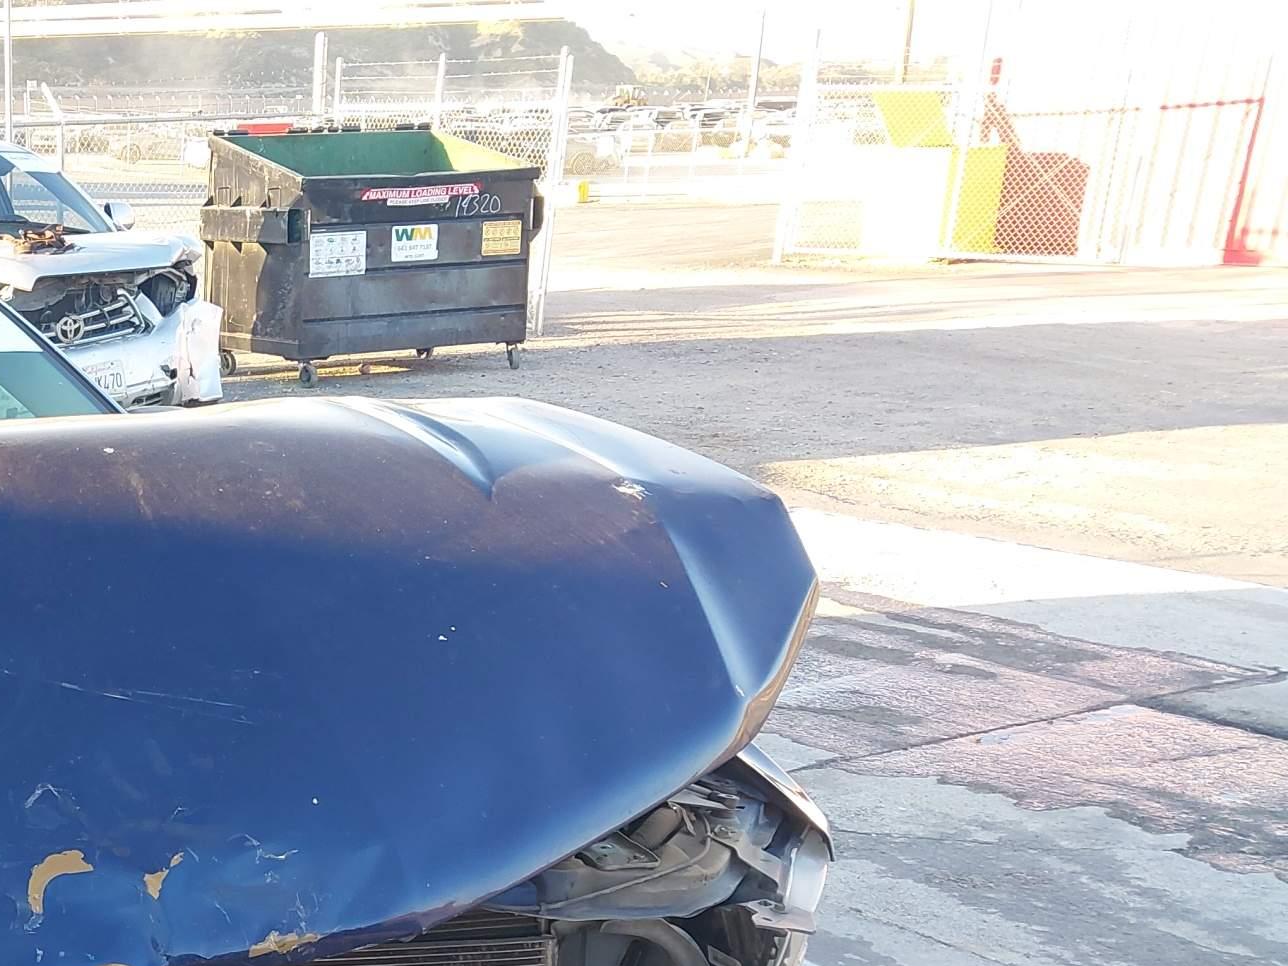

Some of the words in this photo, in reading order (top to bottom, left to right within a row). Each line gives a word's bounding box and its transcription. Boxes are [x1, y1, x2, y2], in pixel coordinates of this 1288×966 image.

[369, 188, 410, 200] MAXIMUM
[411, 186, 447, 197] LOADING
[448, 185, 474, 195] LEVEL
[395, 227, 433, 241] WM
